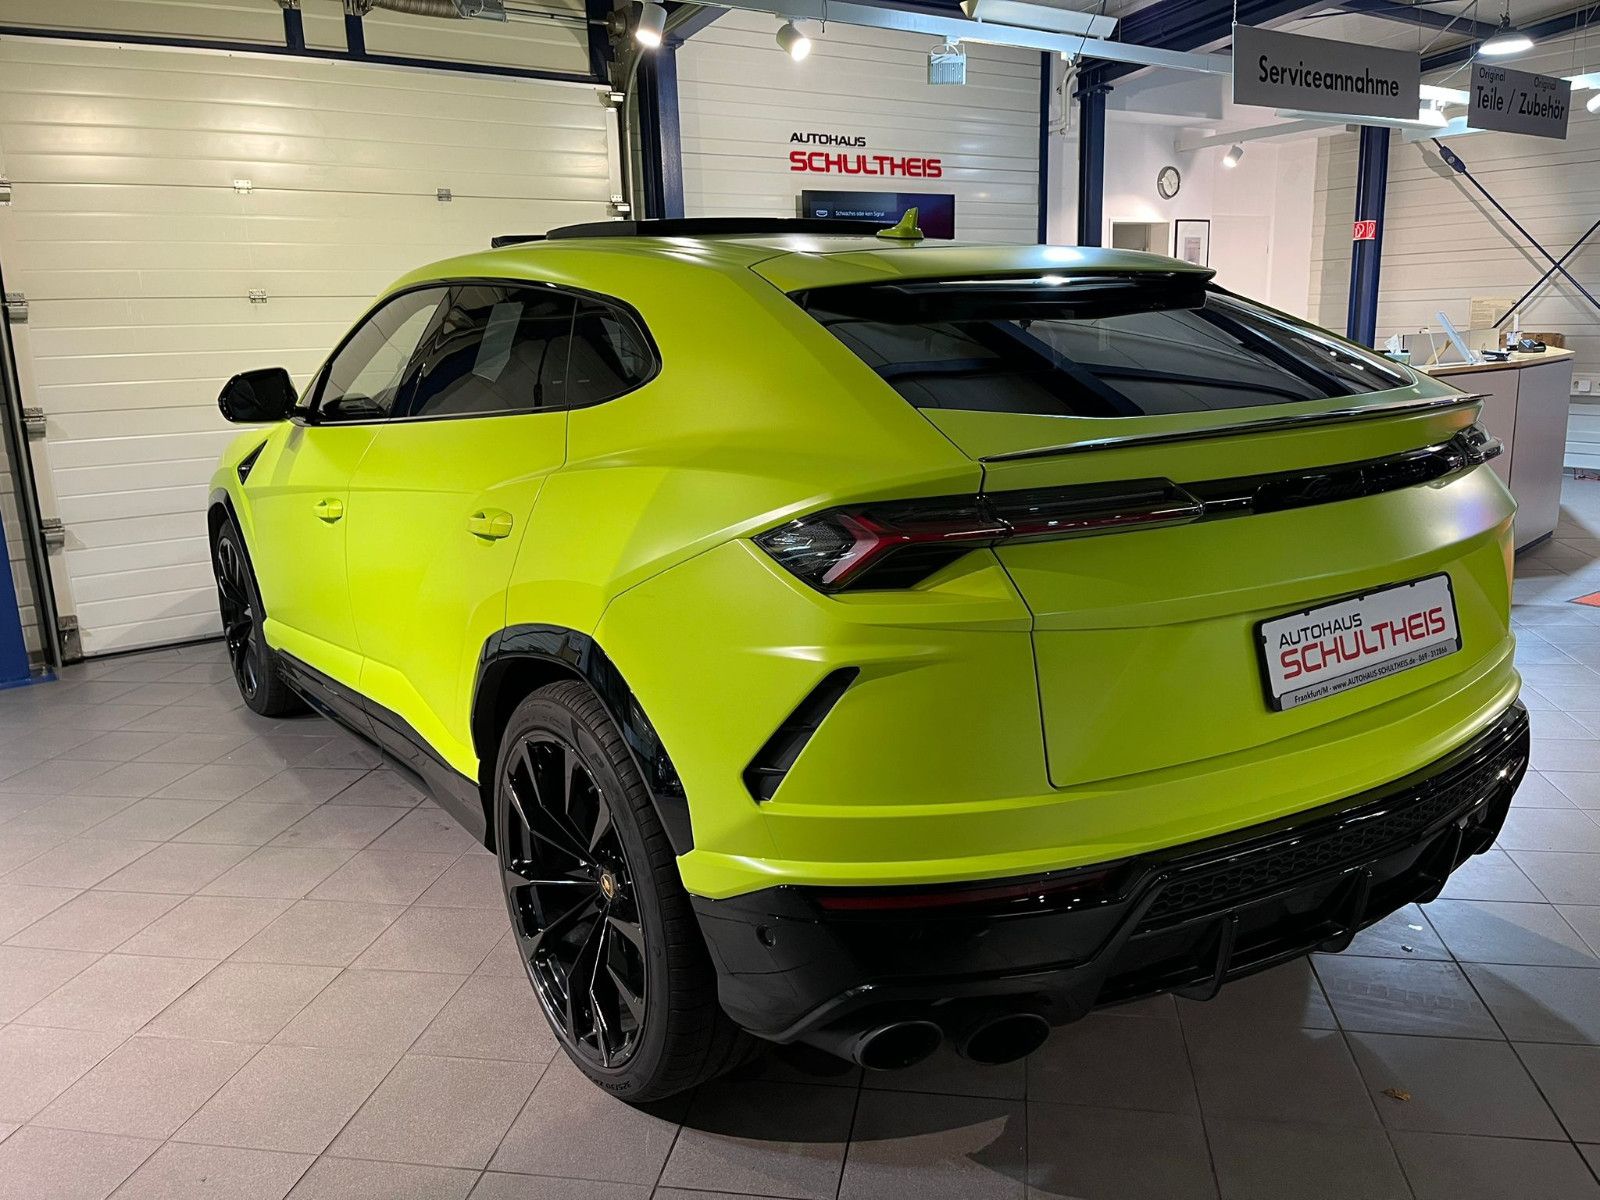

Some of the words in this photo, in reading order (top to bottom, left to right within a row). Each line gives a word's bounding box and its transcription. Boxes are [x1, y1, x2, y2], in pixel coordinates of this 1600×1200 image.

[1258, 54, 1400, 97] Serviceannahme
[1479, 67, 1506, 83] Original
[1533, 77, 1557, 92] Original
[1477, 85, 1504, 111] Teile
[1518, 92, 1565, 120] Zubehör
[790, 132, 866, 147] AUTOHAUS
[789, 150, 943, 178] SCHULTHEIS
[1279, 612, 1363, 649] AUTOHAUS
[1279, 606, 1447, 680] SCHULTHEIS
[1294, 685, 1329, 704] Frankfurt/M
